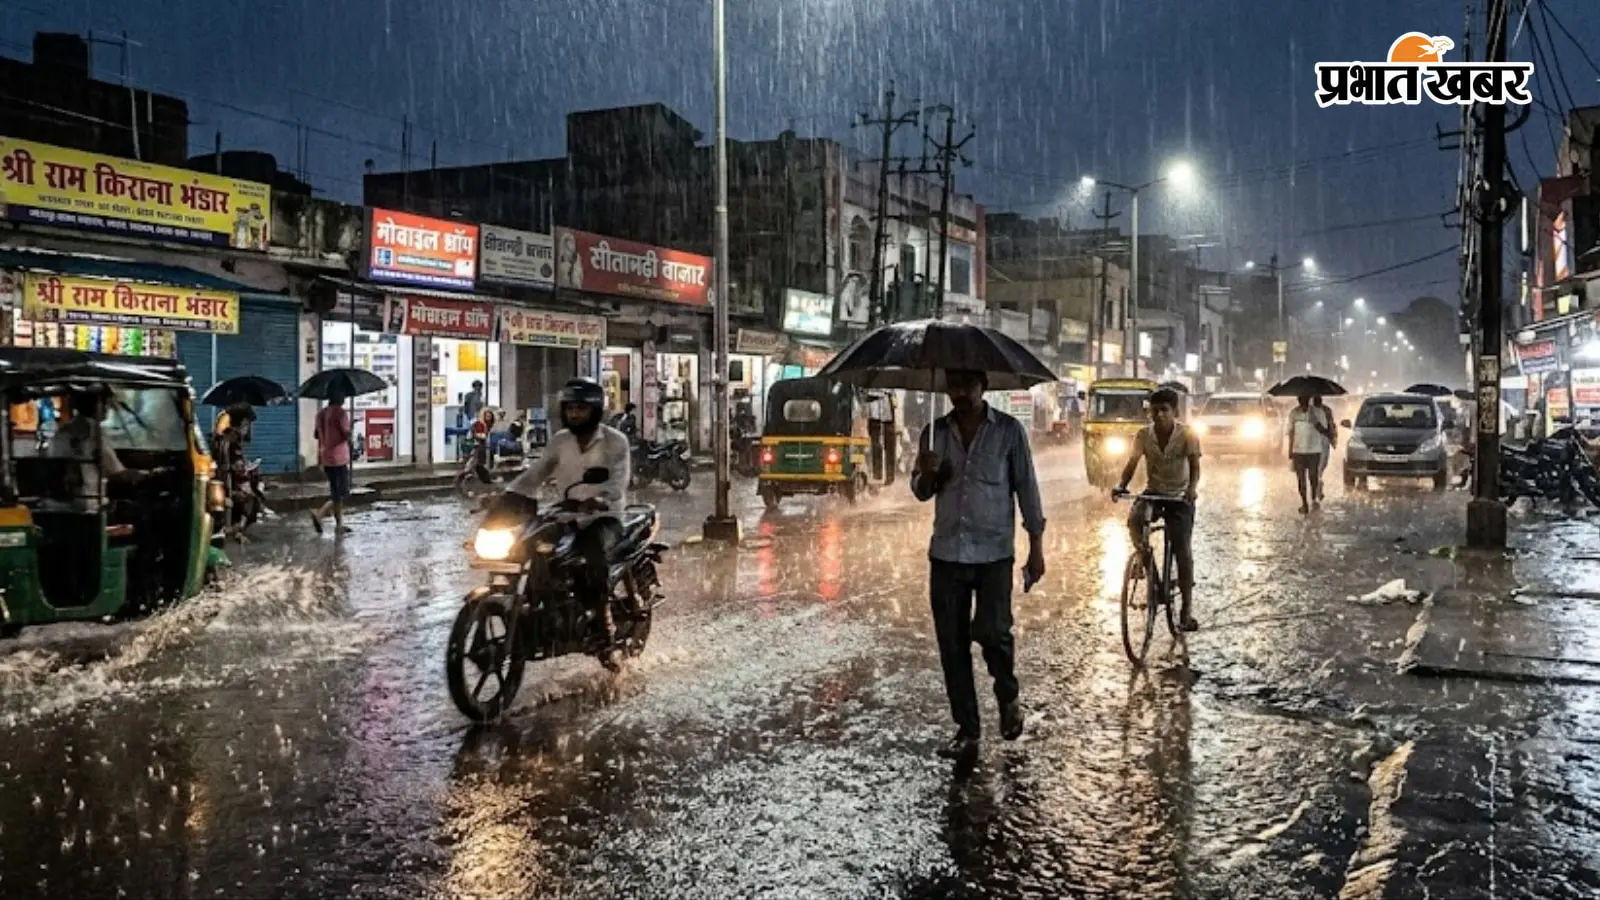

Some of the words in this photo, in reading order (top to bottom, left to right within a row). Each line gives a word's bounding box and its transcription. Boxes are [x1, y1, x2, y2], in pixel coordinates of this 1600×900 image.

[2, 148, 36, 186] श्री
[43, 161, 87, 193] राम
[93, 162, 174, 206] किराना
[180, 178, 230, 214] भंडार
[37, 277, 64, 305] श्री
[72, 286, 107, 307] राम
[112, 284, 179, 314] किराना
[186, 292, 229, 318] भंडार
